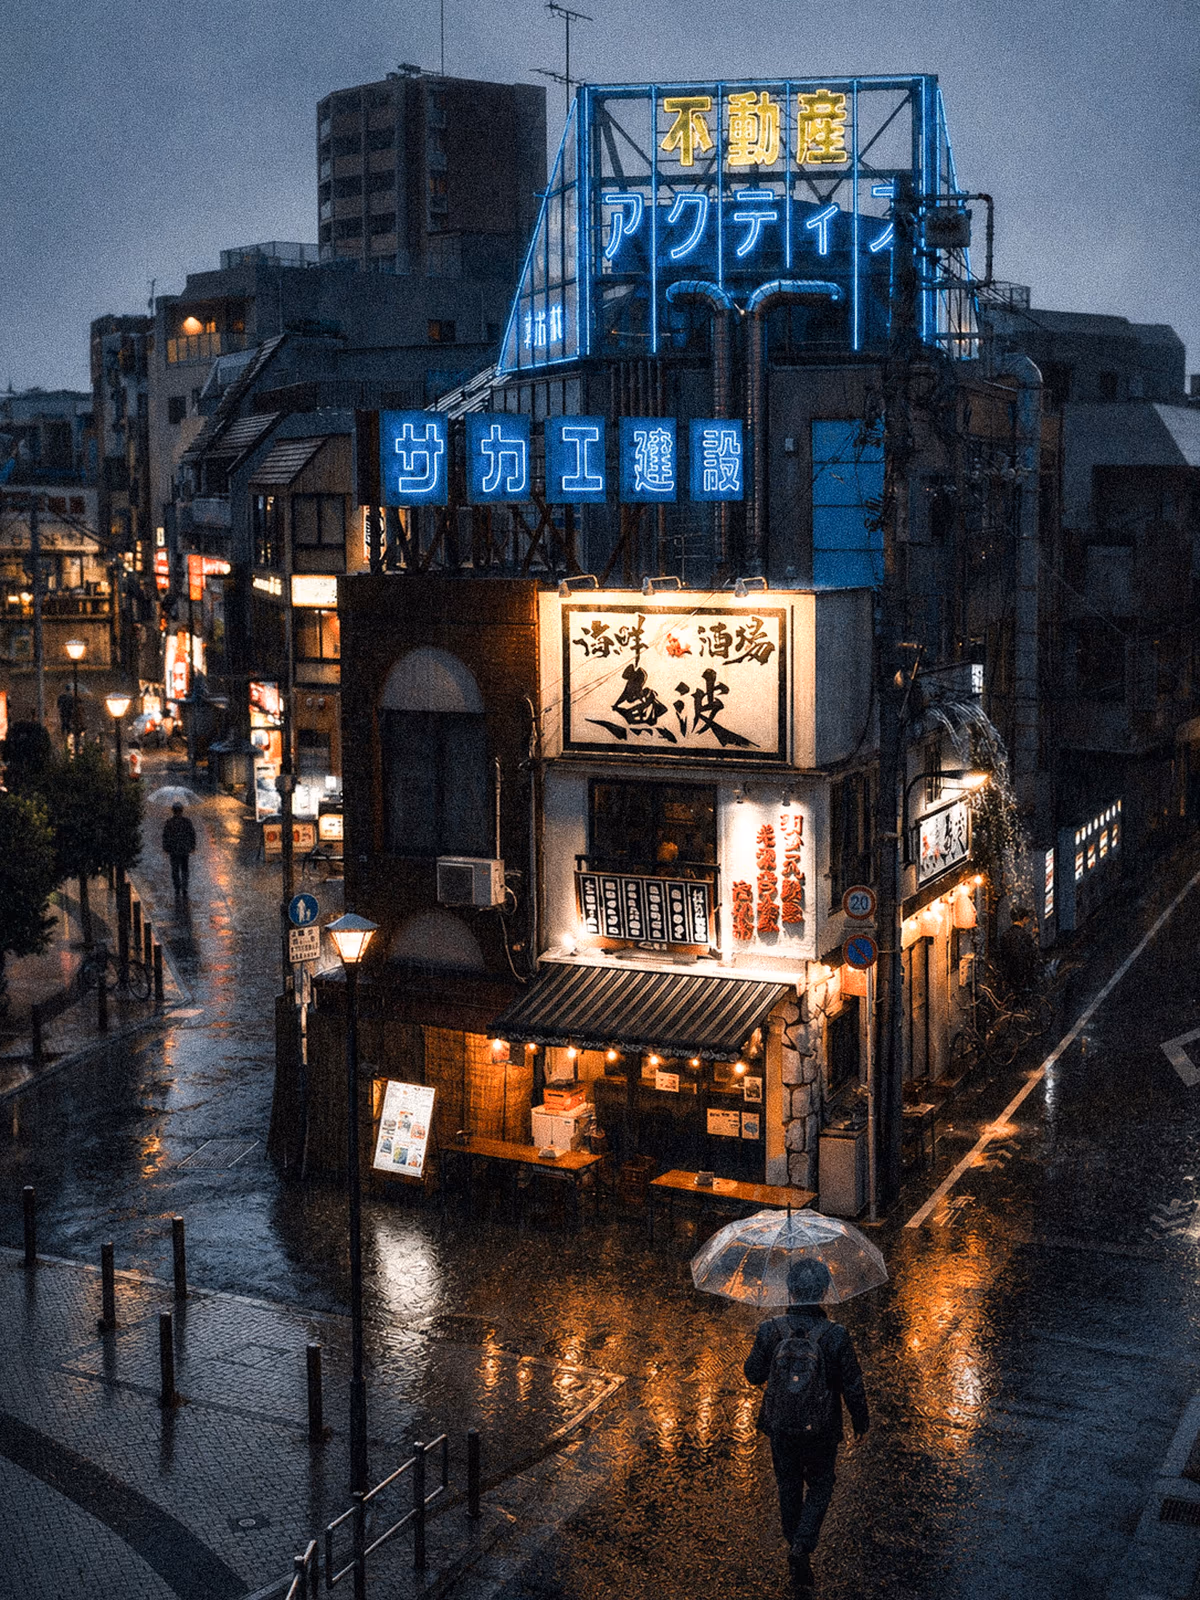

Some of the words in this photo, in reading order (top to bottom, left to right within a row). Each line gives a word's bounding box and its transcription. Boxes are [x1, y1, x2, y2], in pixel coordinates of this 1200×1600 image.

[660, 89, 847, 167] 不動産
[395, 423, 742, 493] サカエ建設
[697, 616, 775, 665] 酒場
[584, 663, 760, 747] 魚波
[850, 894, 869, 910] 20
